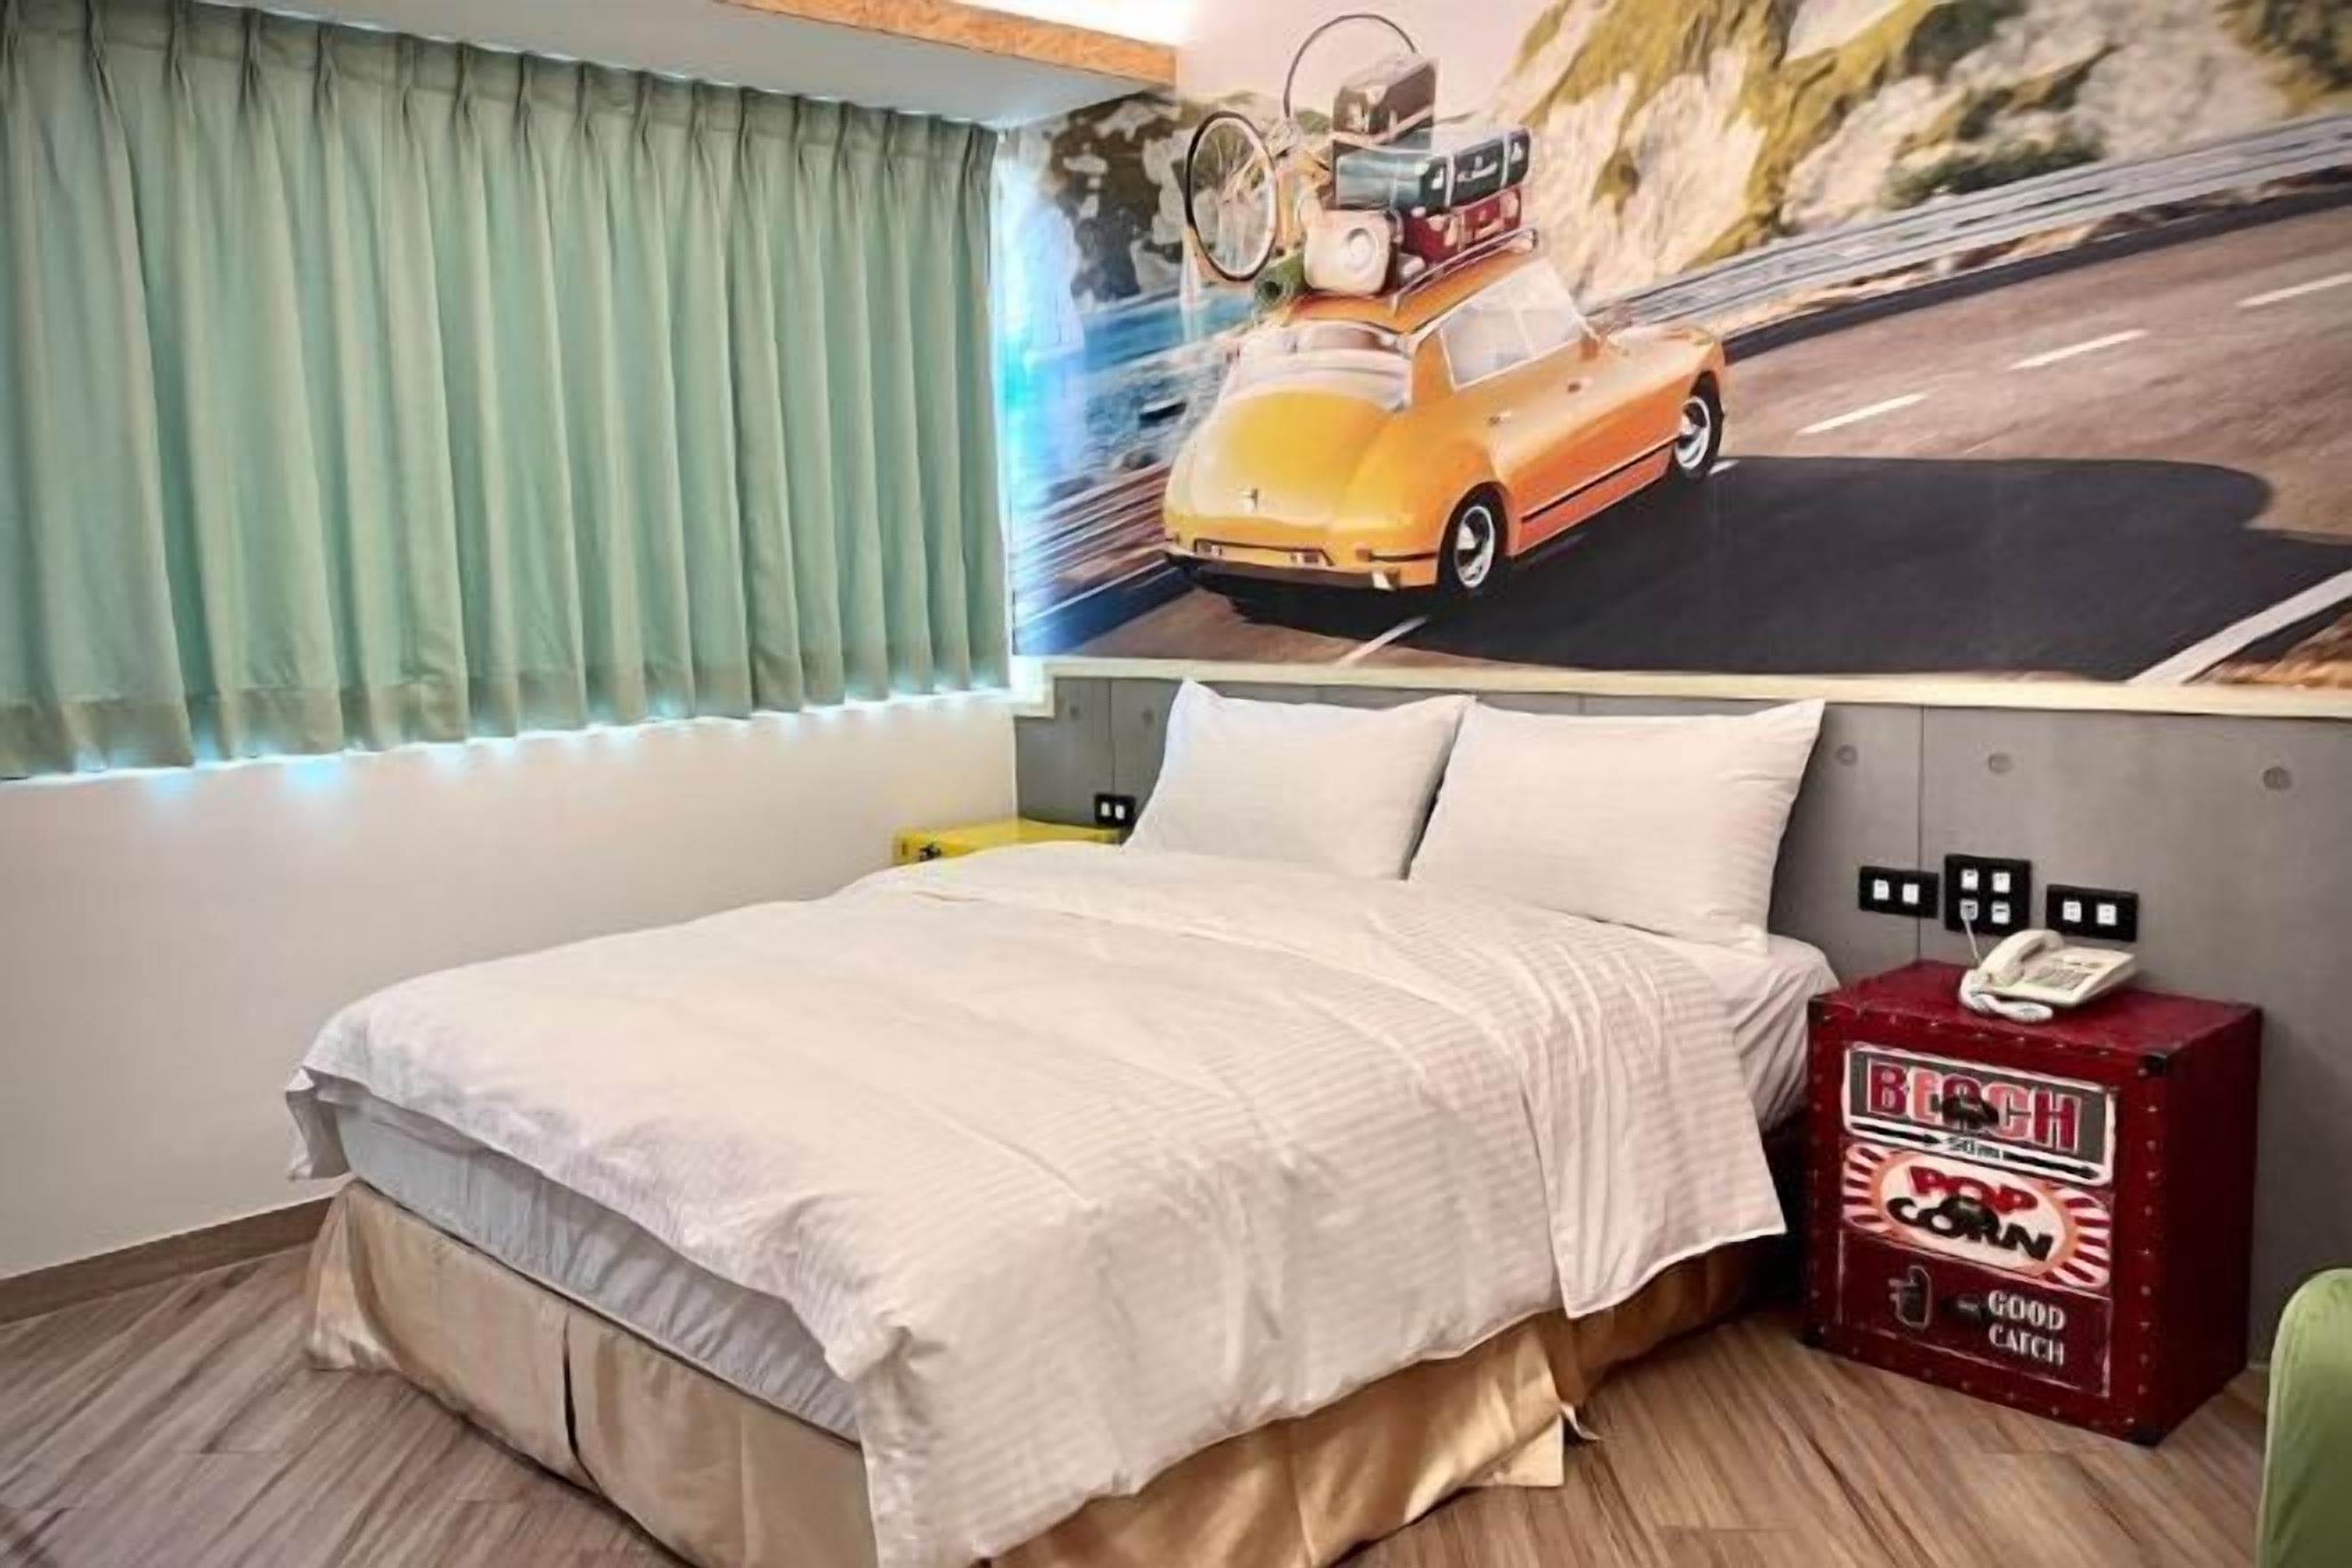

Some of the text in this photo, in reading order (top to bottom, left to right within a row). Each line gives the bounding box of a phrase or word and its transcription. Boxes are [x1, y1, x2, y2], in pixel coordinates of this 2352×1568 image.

[1909, 1165, 2038, 1214] POP
[1887, 1196, 2053, 1262] CORN
[1989, 1290, 2066, 1330] GOOD
[1989, 1323, 2064, 1366] CATCH
